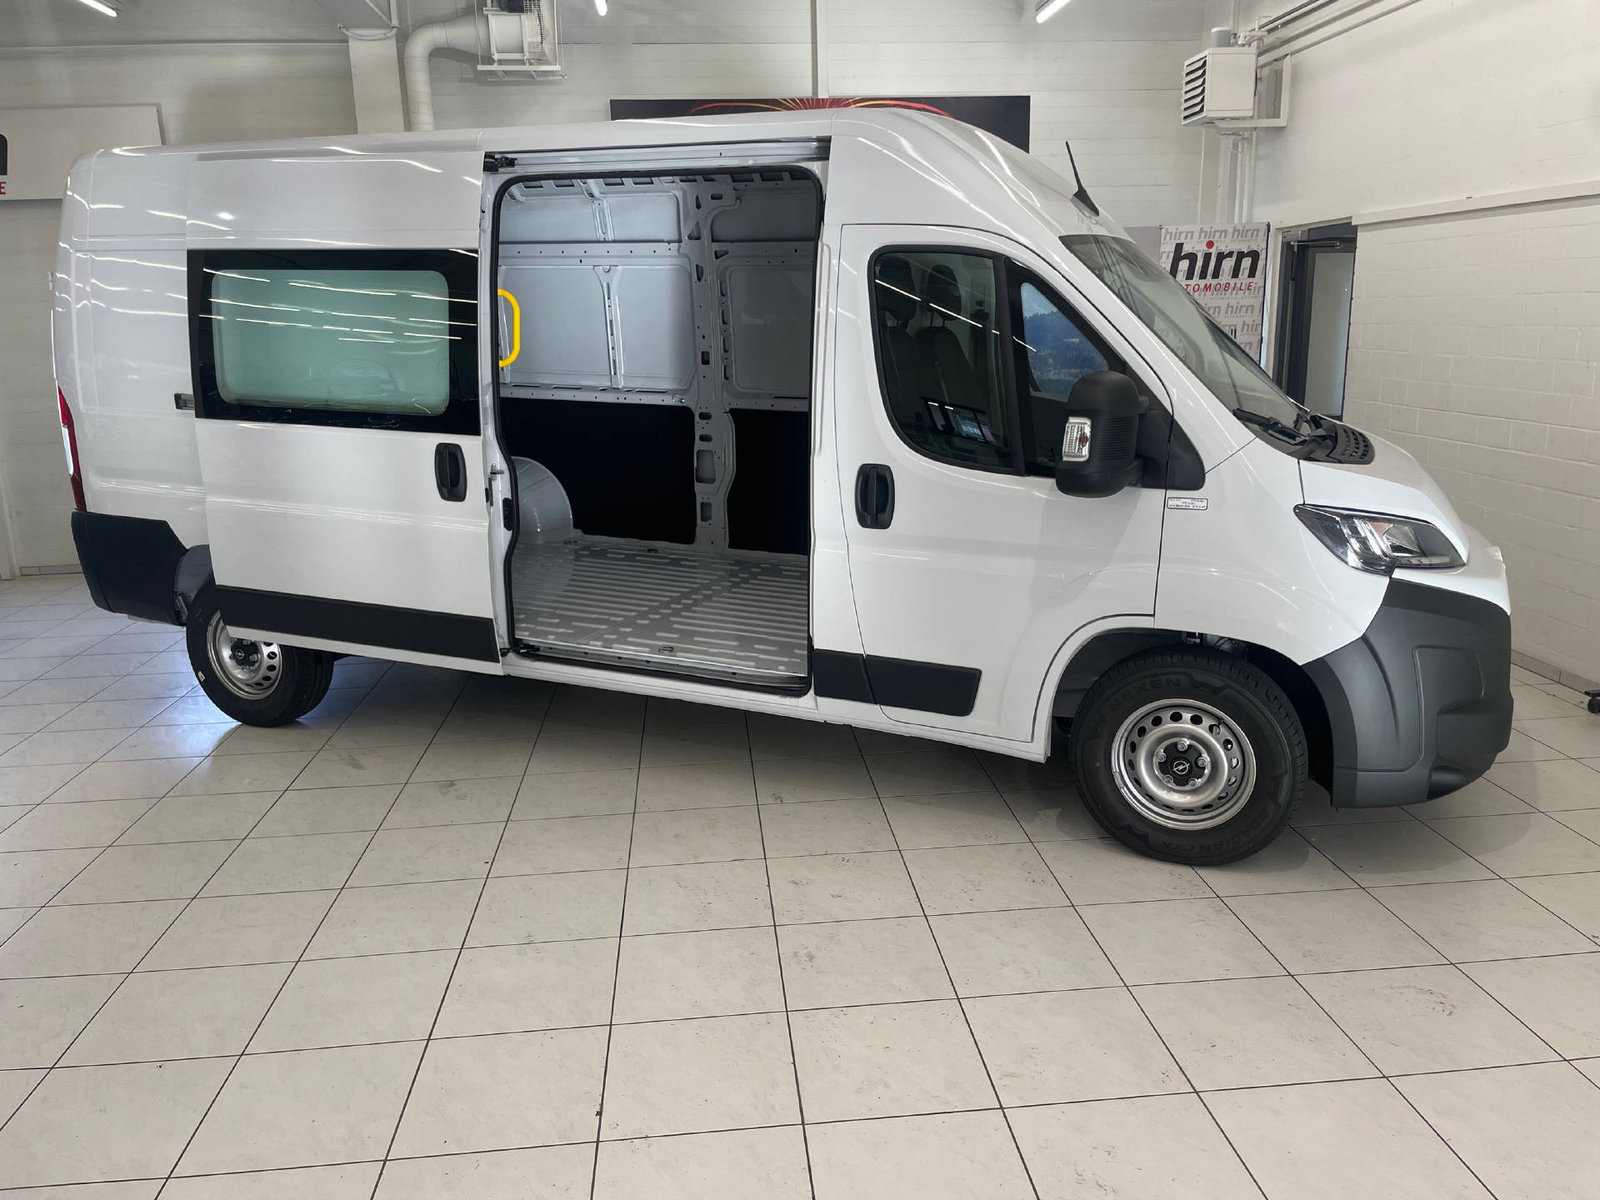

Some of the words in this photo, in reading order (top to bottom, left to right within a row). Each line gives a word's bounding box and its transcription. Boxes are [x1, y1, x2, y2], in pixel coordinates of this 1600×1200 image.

[1163, 227, 1194, 241] hirn
[1198, 226, 1228, 240] hirn
[1231, 225, 1260, 239] hirn
[1169, 240, 1260, 281] hirn
[1184, 281, 1254, 293] TOMOBILE
[1225, 301, 1255, 315] hirn
[1241, 319, 1262, 333] hir
